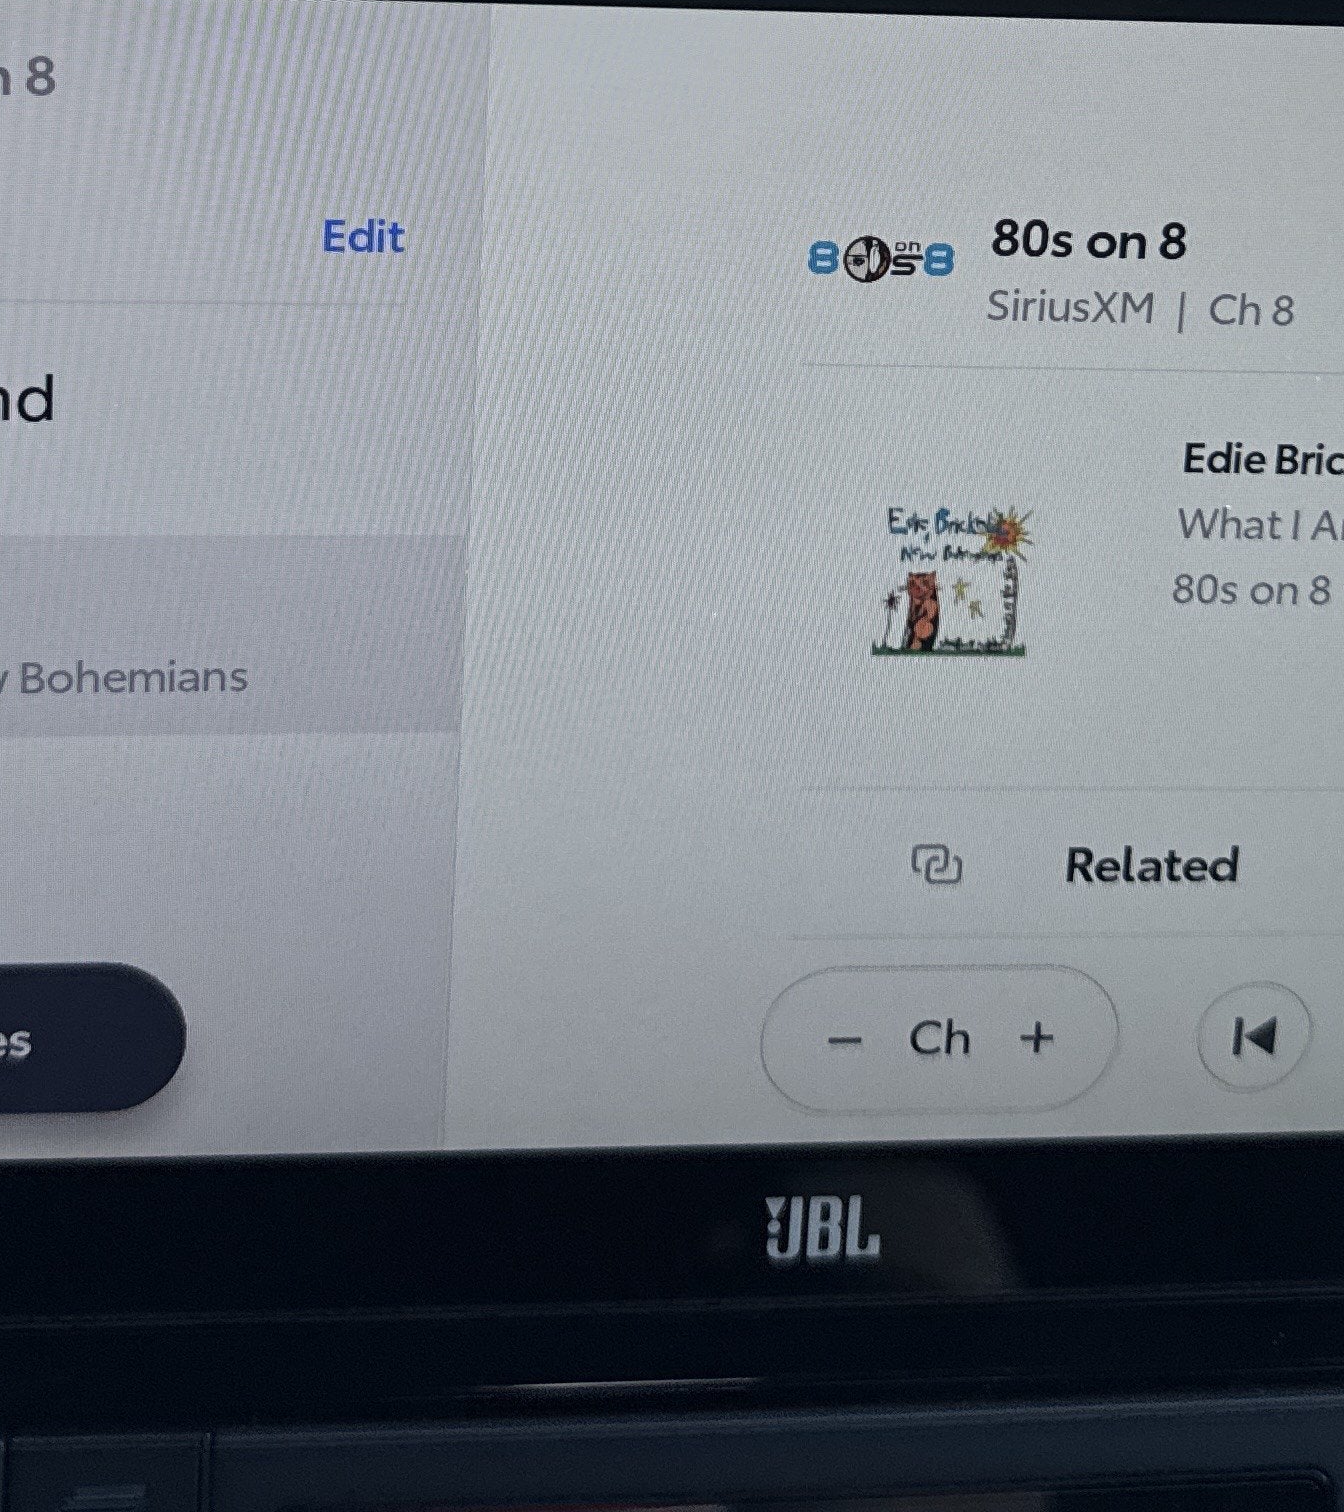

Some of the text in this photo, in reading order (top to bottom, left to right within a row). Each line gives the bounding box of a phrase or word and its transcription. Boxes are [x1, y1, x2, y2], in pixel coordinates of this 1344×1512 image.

[26, 55, 57, 98] 8
[323, 218, 406, 255] Edit
[991, 219, 1188, 262] 80s on 8
[987, 289, 1155, 326] SiriusXM
[1208, 293, 1262, 327] Ch
[1272, 295, 1295, 328] 8
[1183, 442, 1268, 476] Edie
[1178, 508, 1283, 542] What
[1291, 510, 1302, 542] I
[1172, 574, 1239, 606] 80s
[1251, 582, 1300, 607] on
[1308, 575, 1332, 607] 8
[20, 659, 249, 696] Bohemians
[1066, 845, 1240, 885] Related
[910, 1019, 972, 1057] Ch
[767, 1195, 882, 1261] JBL
